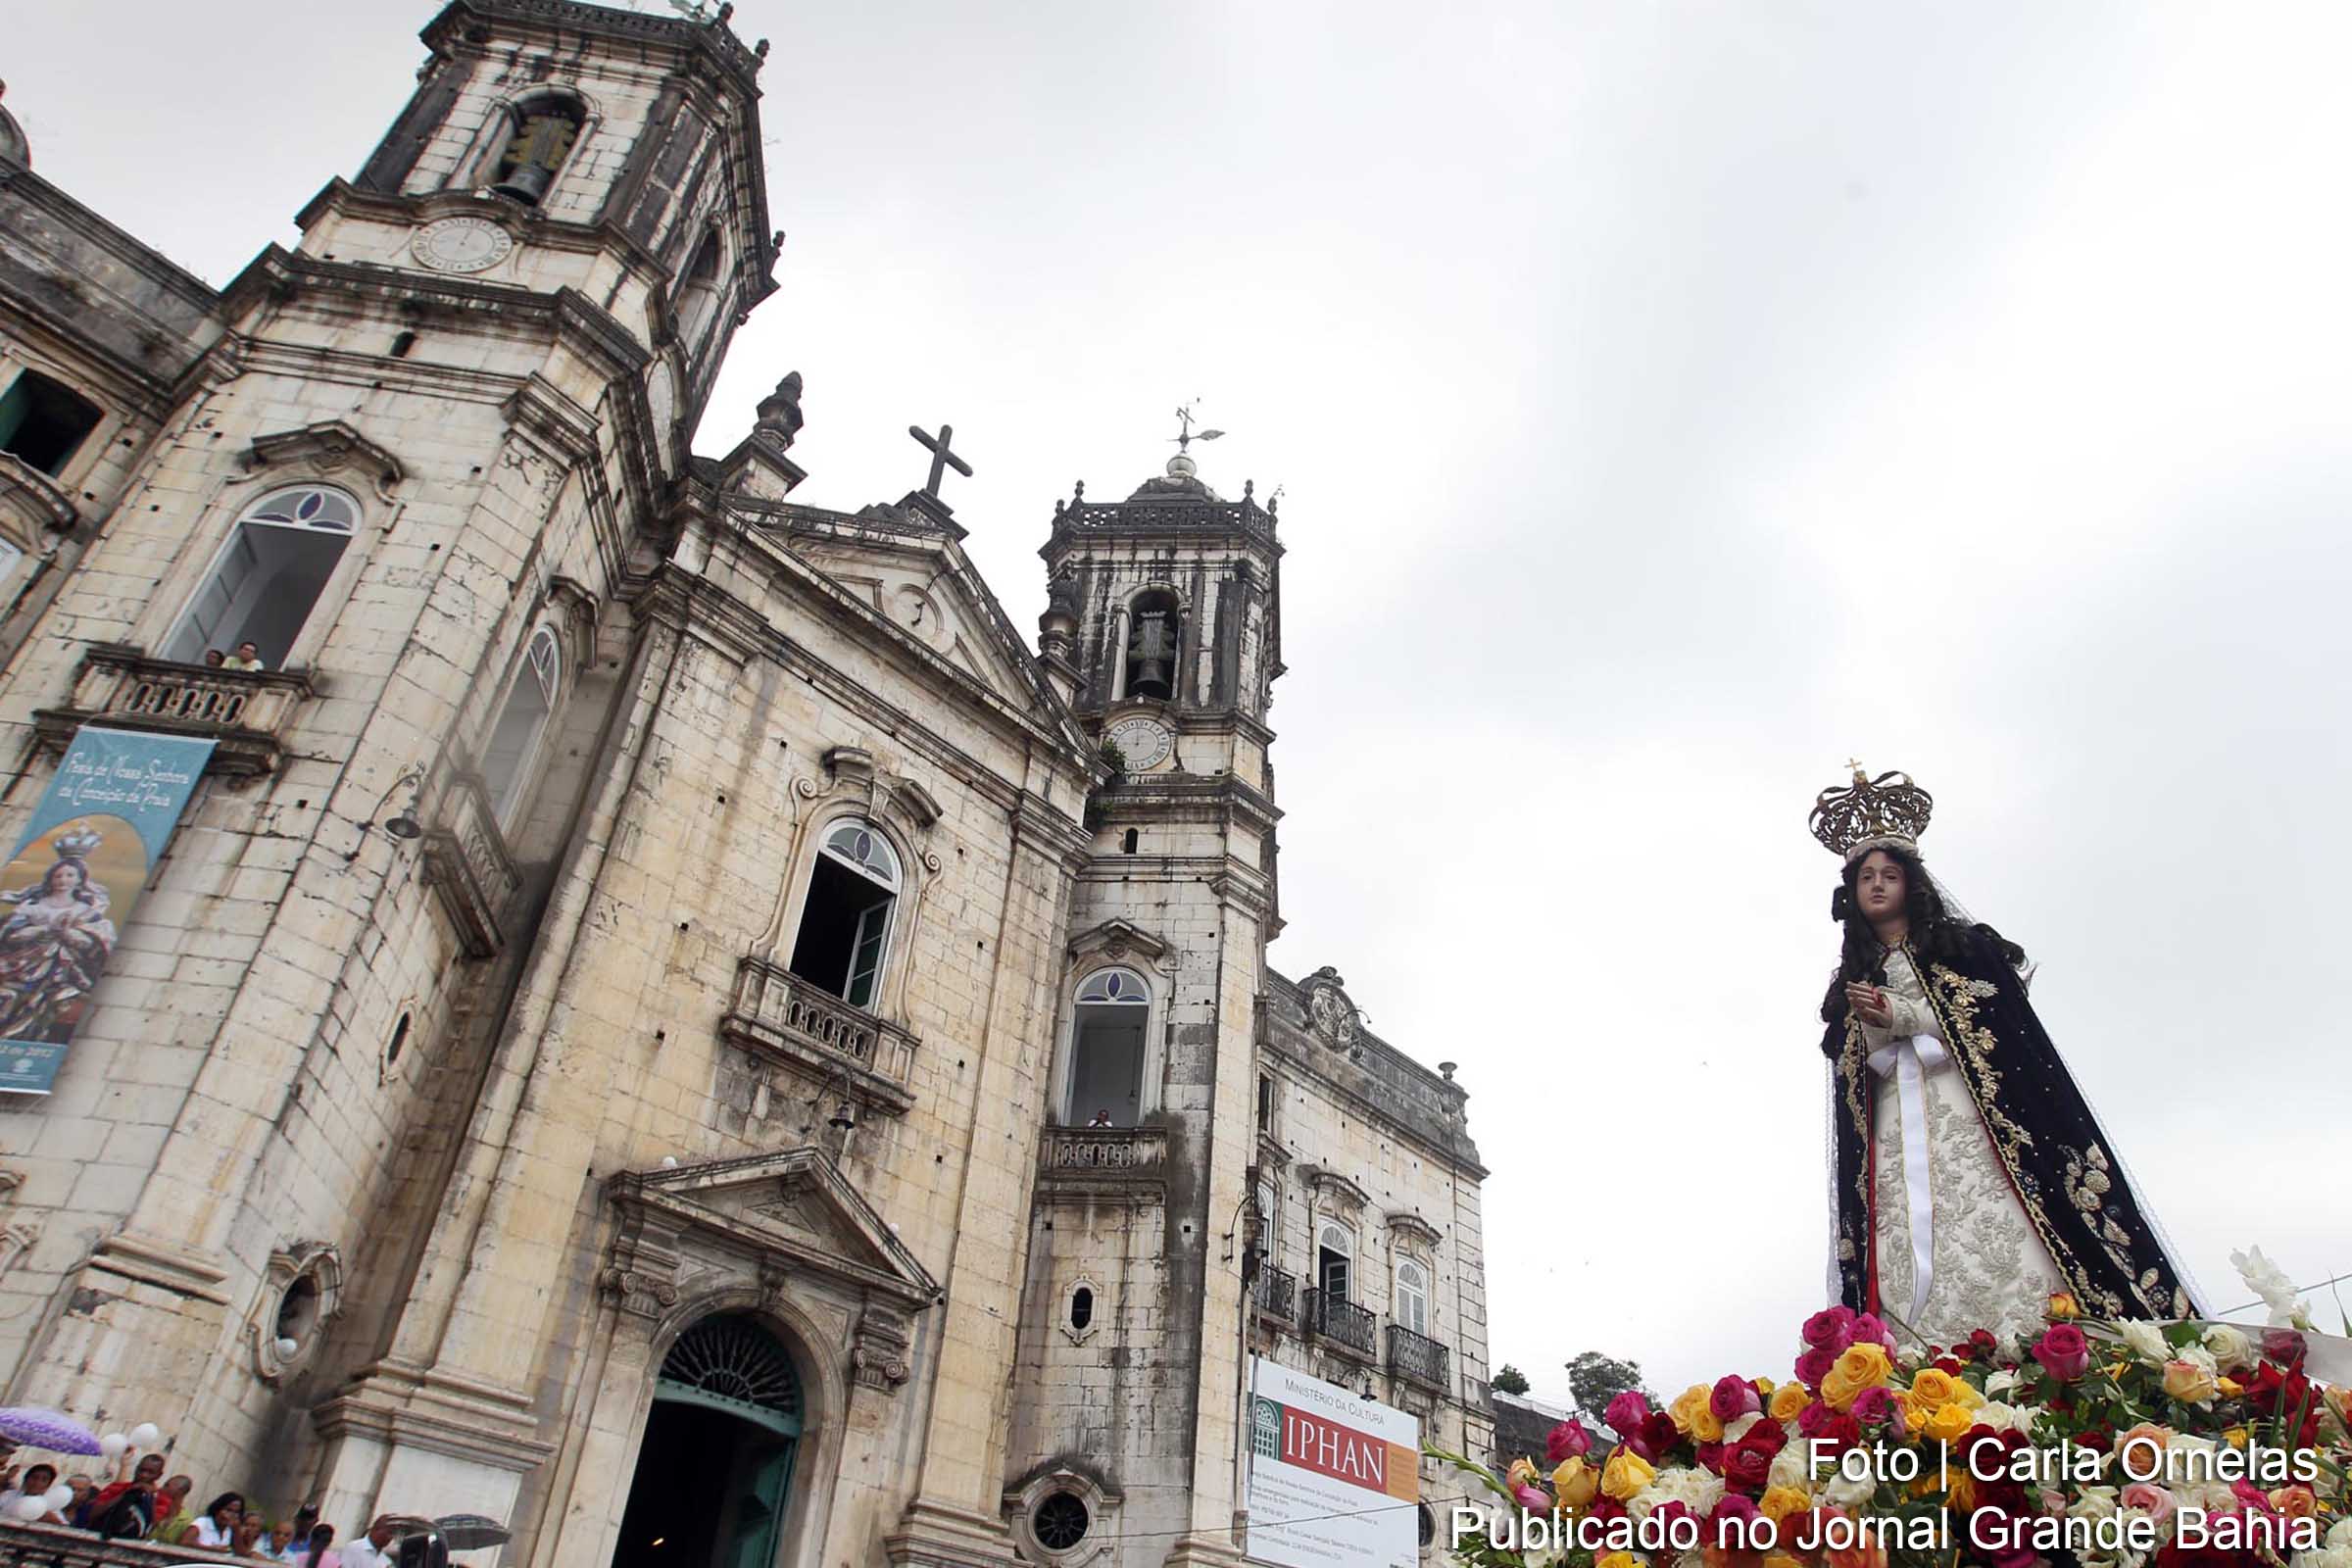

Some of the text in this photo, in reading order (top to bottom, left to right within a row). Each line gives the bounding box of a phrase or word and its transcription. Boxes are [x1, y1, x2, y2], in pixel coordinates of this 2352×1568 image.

[1285, 1379, 1385, 1427] MINISTÉRIO DA CULTURA
[1286, 1414, 1385, 1486] IPHAN
